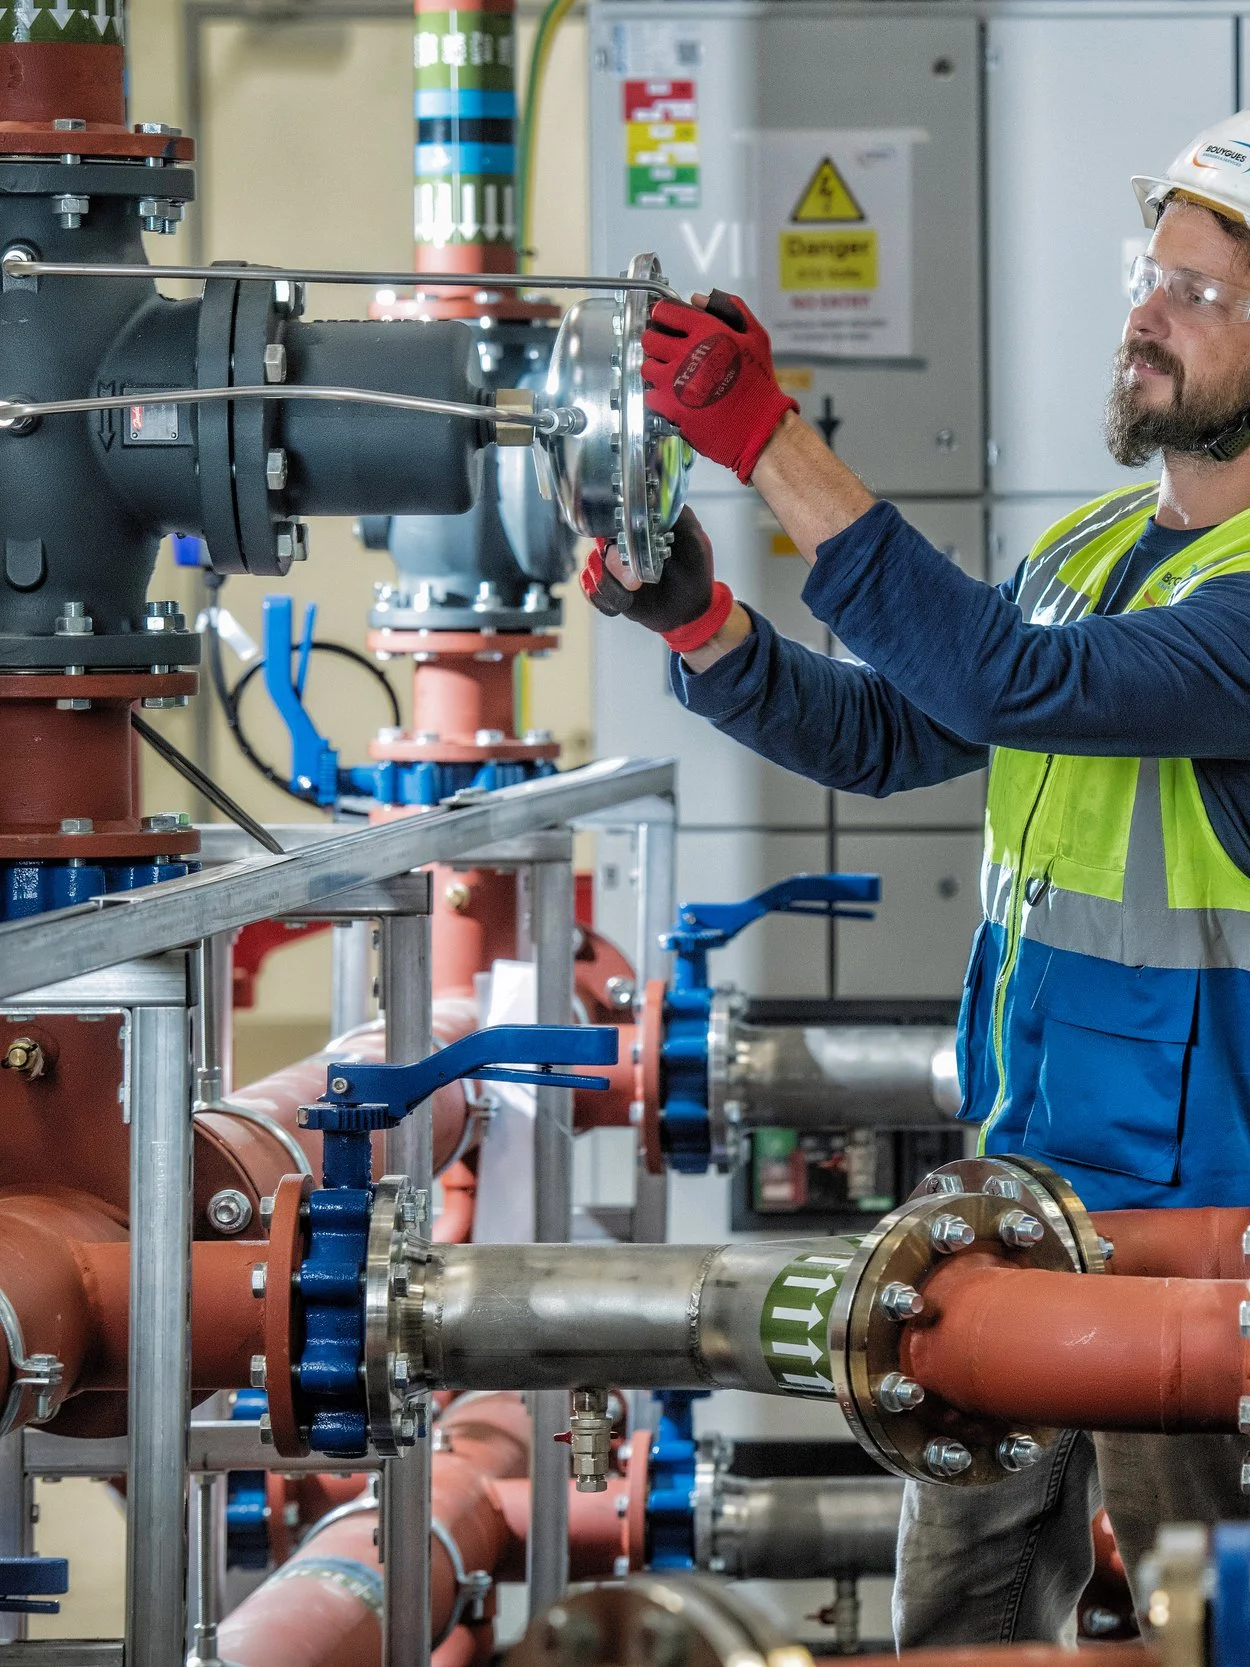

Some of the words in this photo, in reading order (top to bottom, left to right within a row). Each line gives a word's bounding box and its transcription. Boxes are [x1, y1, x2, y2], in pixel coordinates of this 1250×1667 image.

[1206, 145, 1247, 163] BOUYGUES
[786, 237, 869, 261] Danger
[674, 344, 711, 387] Traffi
